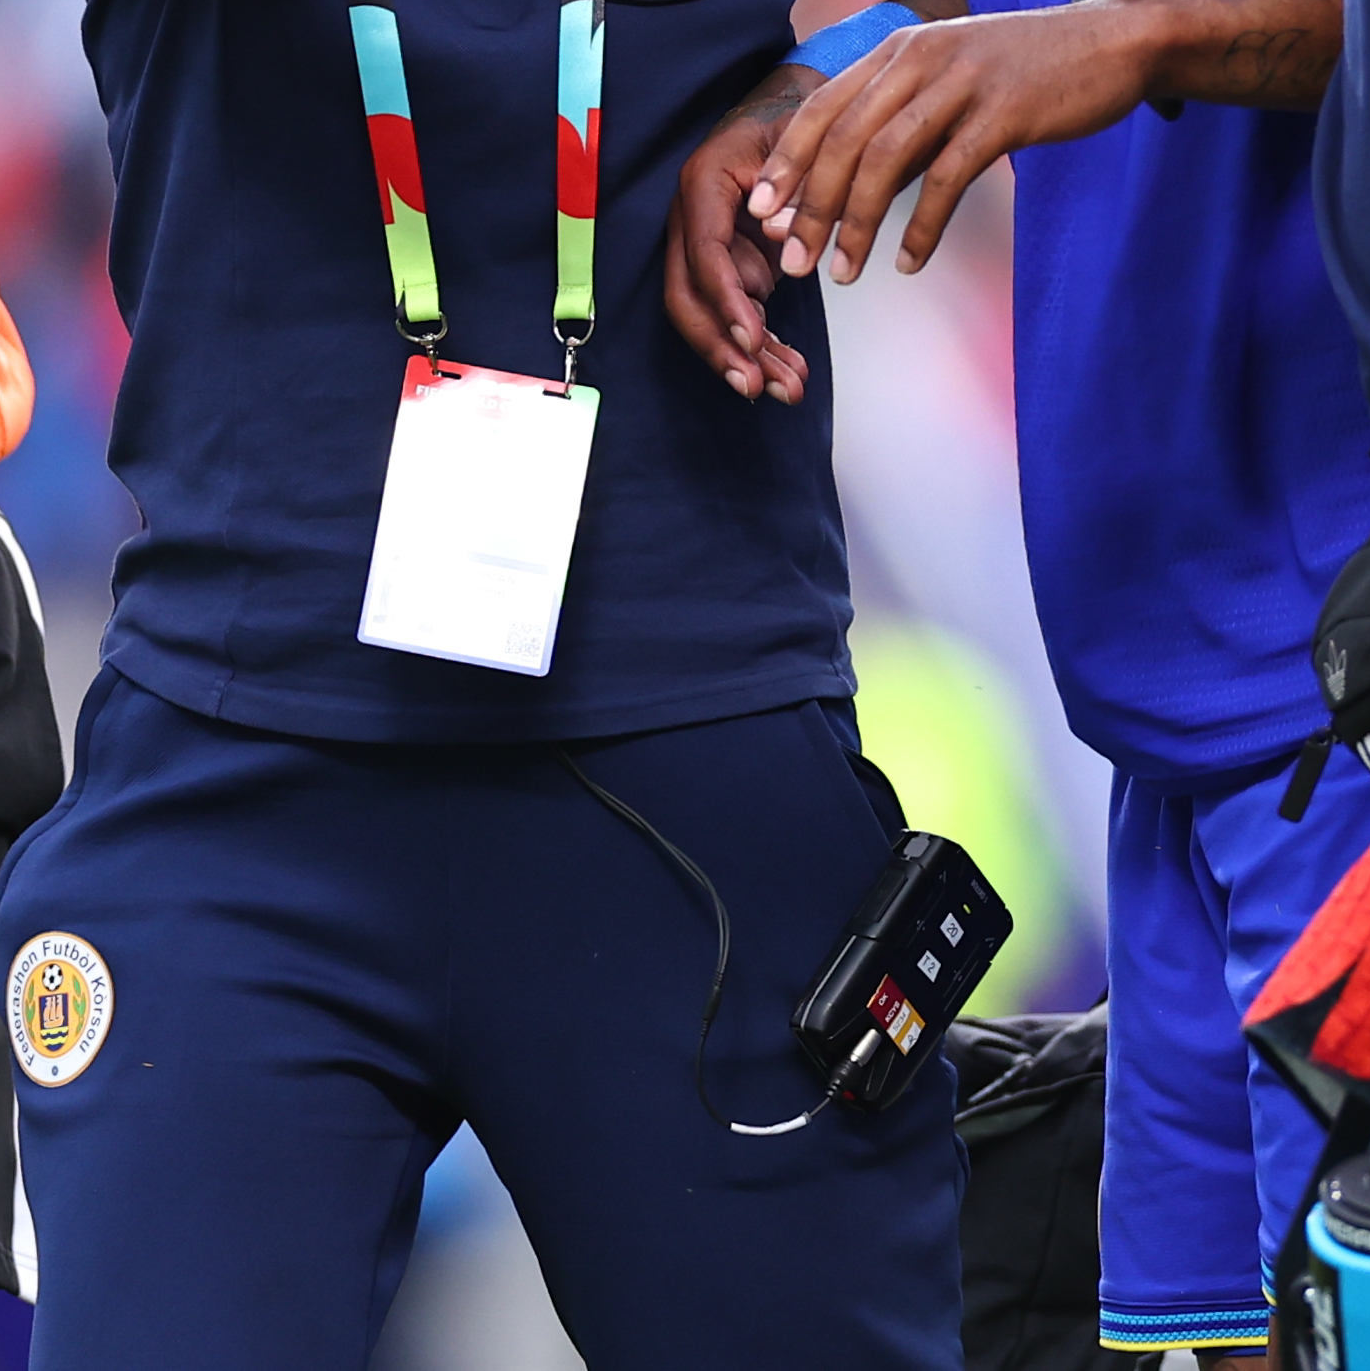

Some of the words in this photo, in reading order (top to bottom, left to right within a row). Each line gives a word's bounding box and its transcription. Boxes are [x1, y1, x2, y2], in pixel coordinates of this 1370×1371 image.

[947, 922, 958, 938] 20
[12, 951, 38, 1067] Federashon
[42, 940, 97, 974] Futbòl
[78, 975, 107, 1054] Kòrsou
